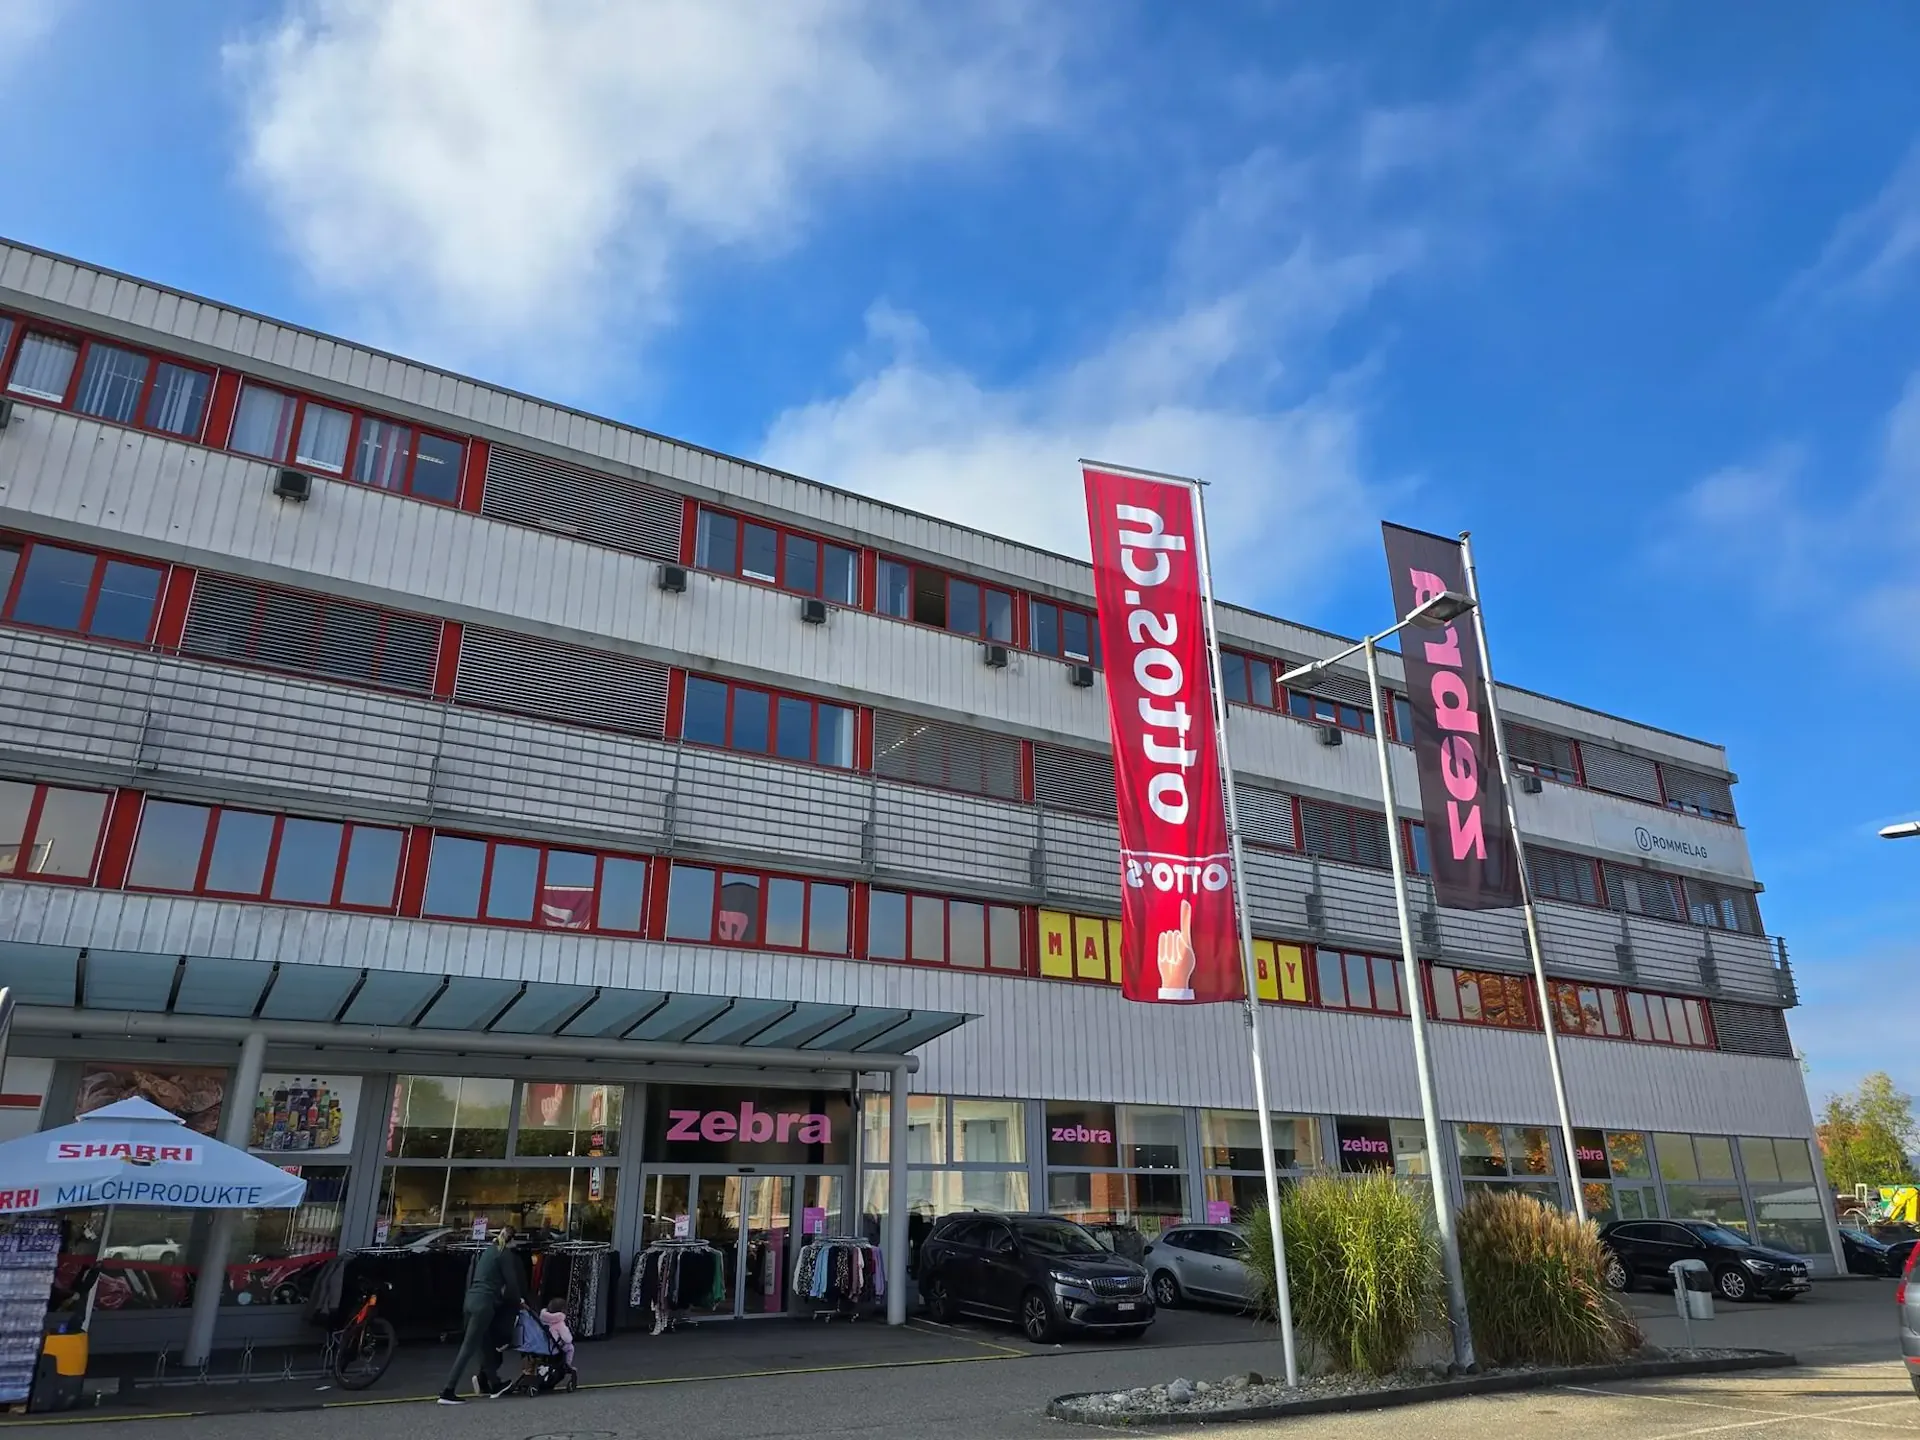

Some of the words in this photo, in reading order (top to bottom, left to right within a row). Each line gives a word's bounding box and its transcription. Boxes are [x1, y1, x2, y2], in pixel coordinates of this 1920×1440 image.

[1652, 835, 1708, 859] ROMMELAG
[666, 1101, 832, 1144] zebra
[1051, 1124, 1112, 1143] zebra
[57, 1143, 193, 1163] SHARRI
[1342, 1136, 1388, 1153] zebra
[1575, 1145, 1604, 1160] ebra
[56, 1181, 263, 1205] MILCHPRODUKTE
